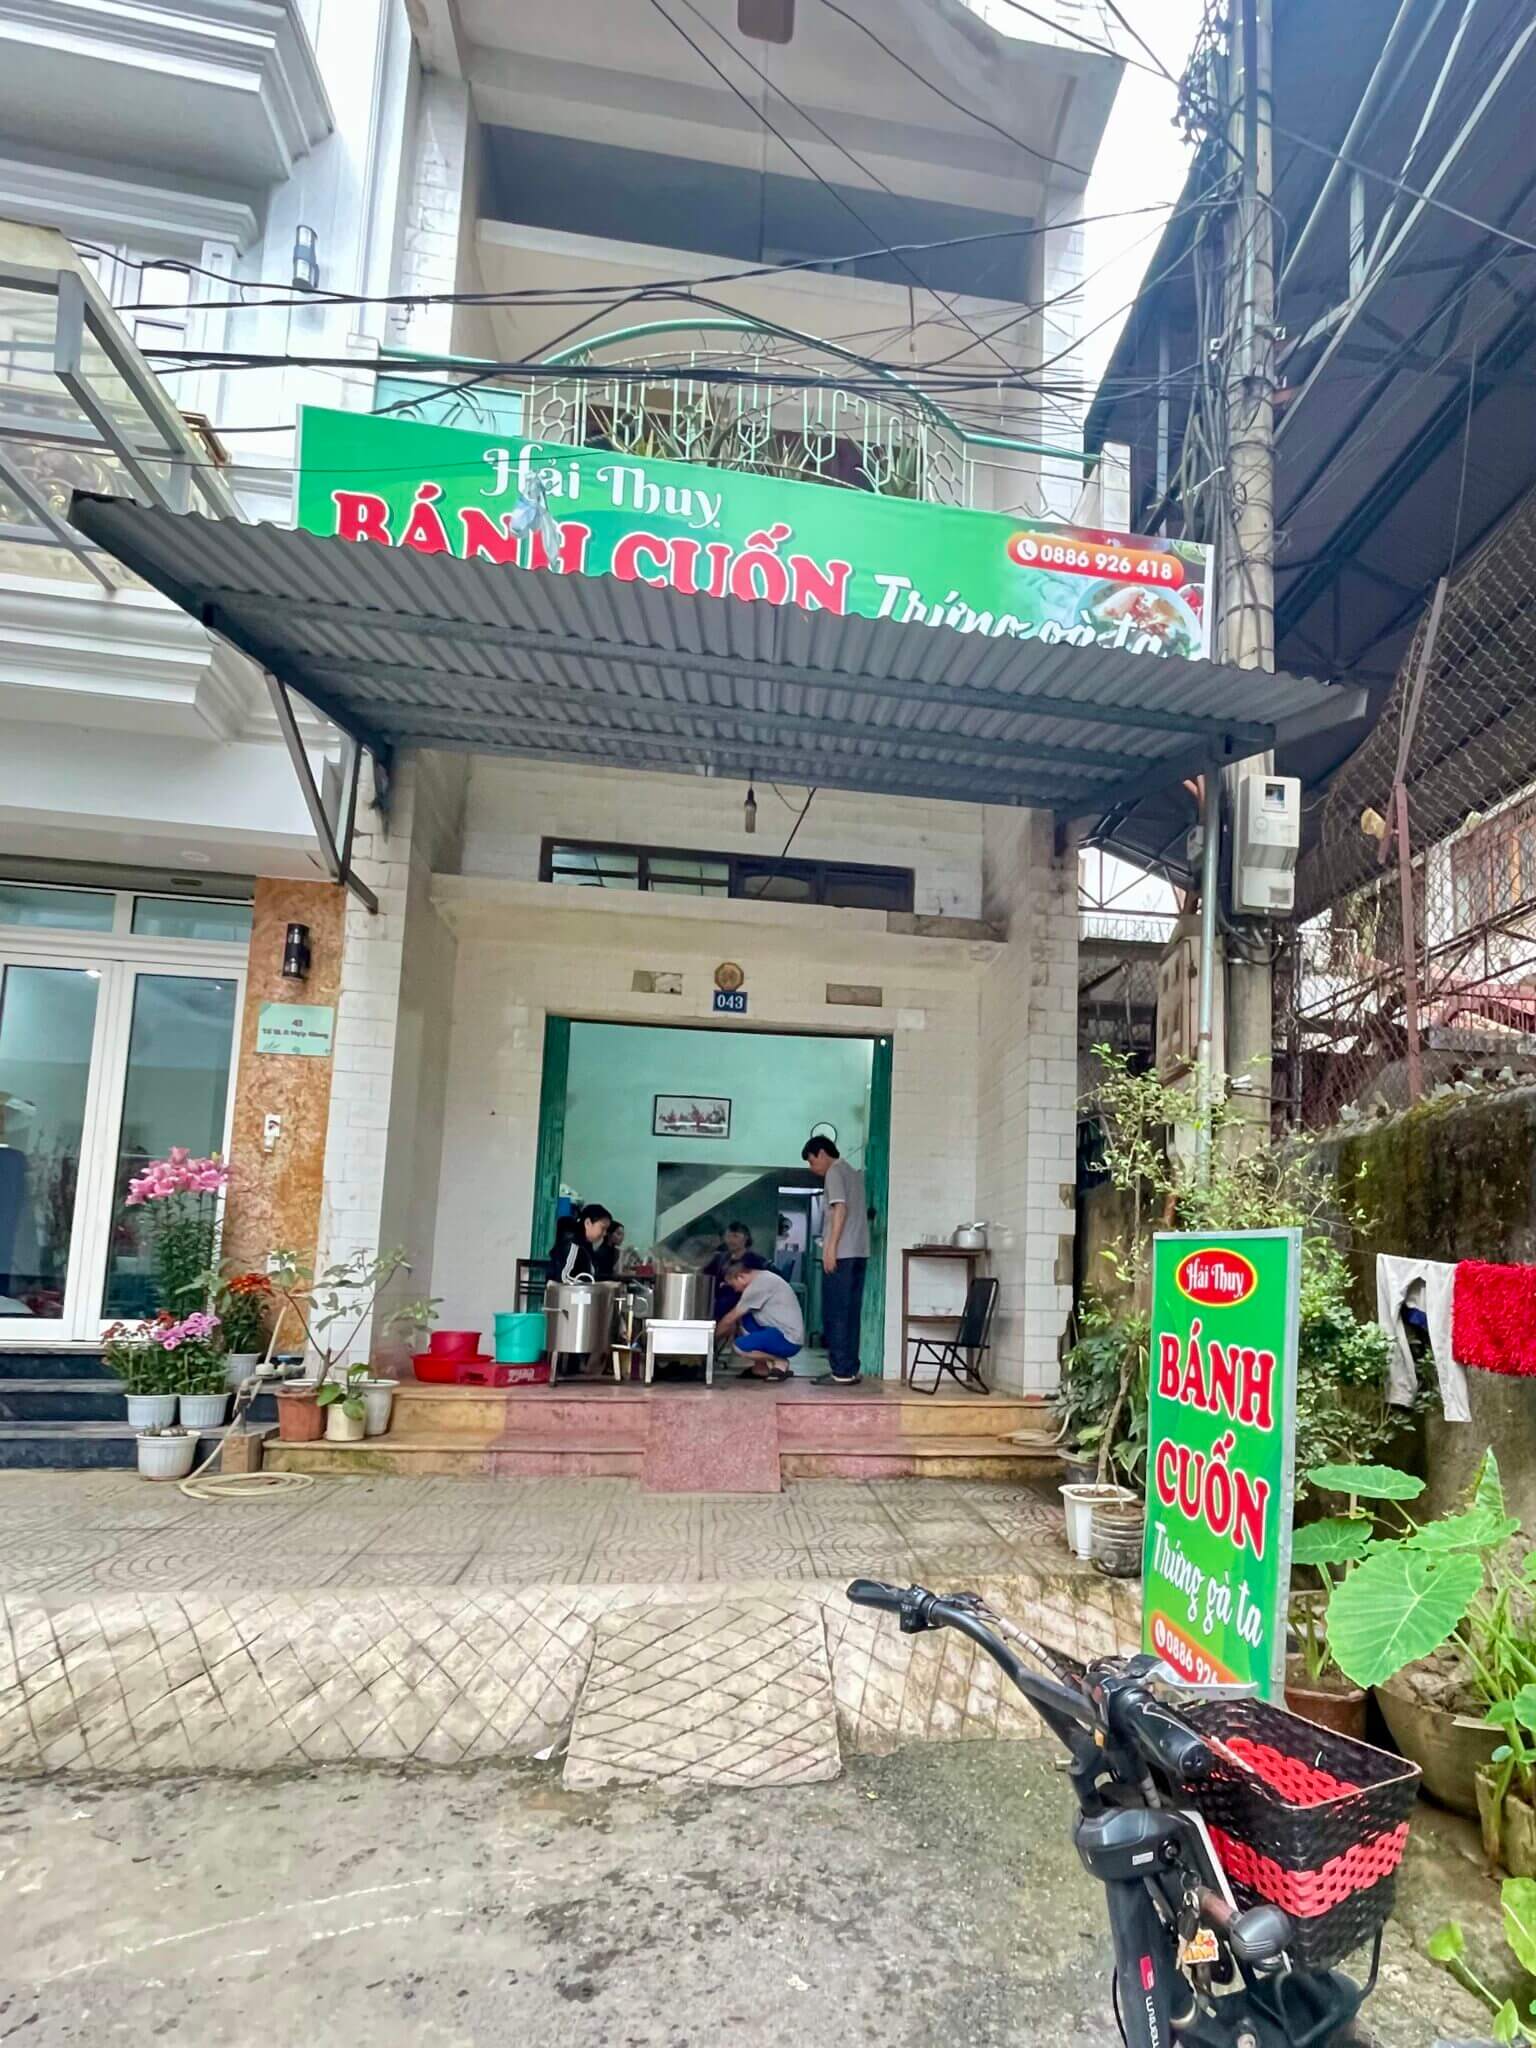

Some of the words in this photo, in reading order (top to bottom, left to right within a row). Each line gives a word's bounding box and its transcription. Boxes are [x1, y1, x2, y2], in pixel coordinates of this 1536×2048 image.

[479, 444, 581, 500] Hải
[610, 522, 853, 616] CUỐN
[1039, 543, 1089, 569] 0886
[1095, 552, 1131, 574] 926
[1136, 558, 1173, 580] 418
[716, 994, 744, 1009] 043
[1158, 1318, 1275, 1430] BÁNH
[1156, 1430, 1270, 1562] CUỐN
[1154, 1520, 1205, 1622] Trứng
[1203, 1570, 1233, 1635] gà
[1235, 1579, 1264, 1648] ta
[1166, 1629, 1193, 1673] 0886
